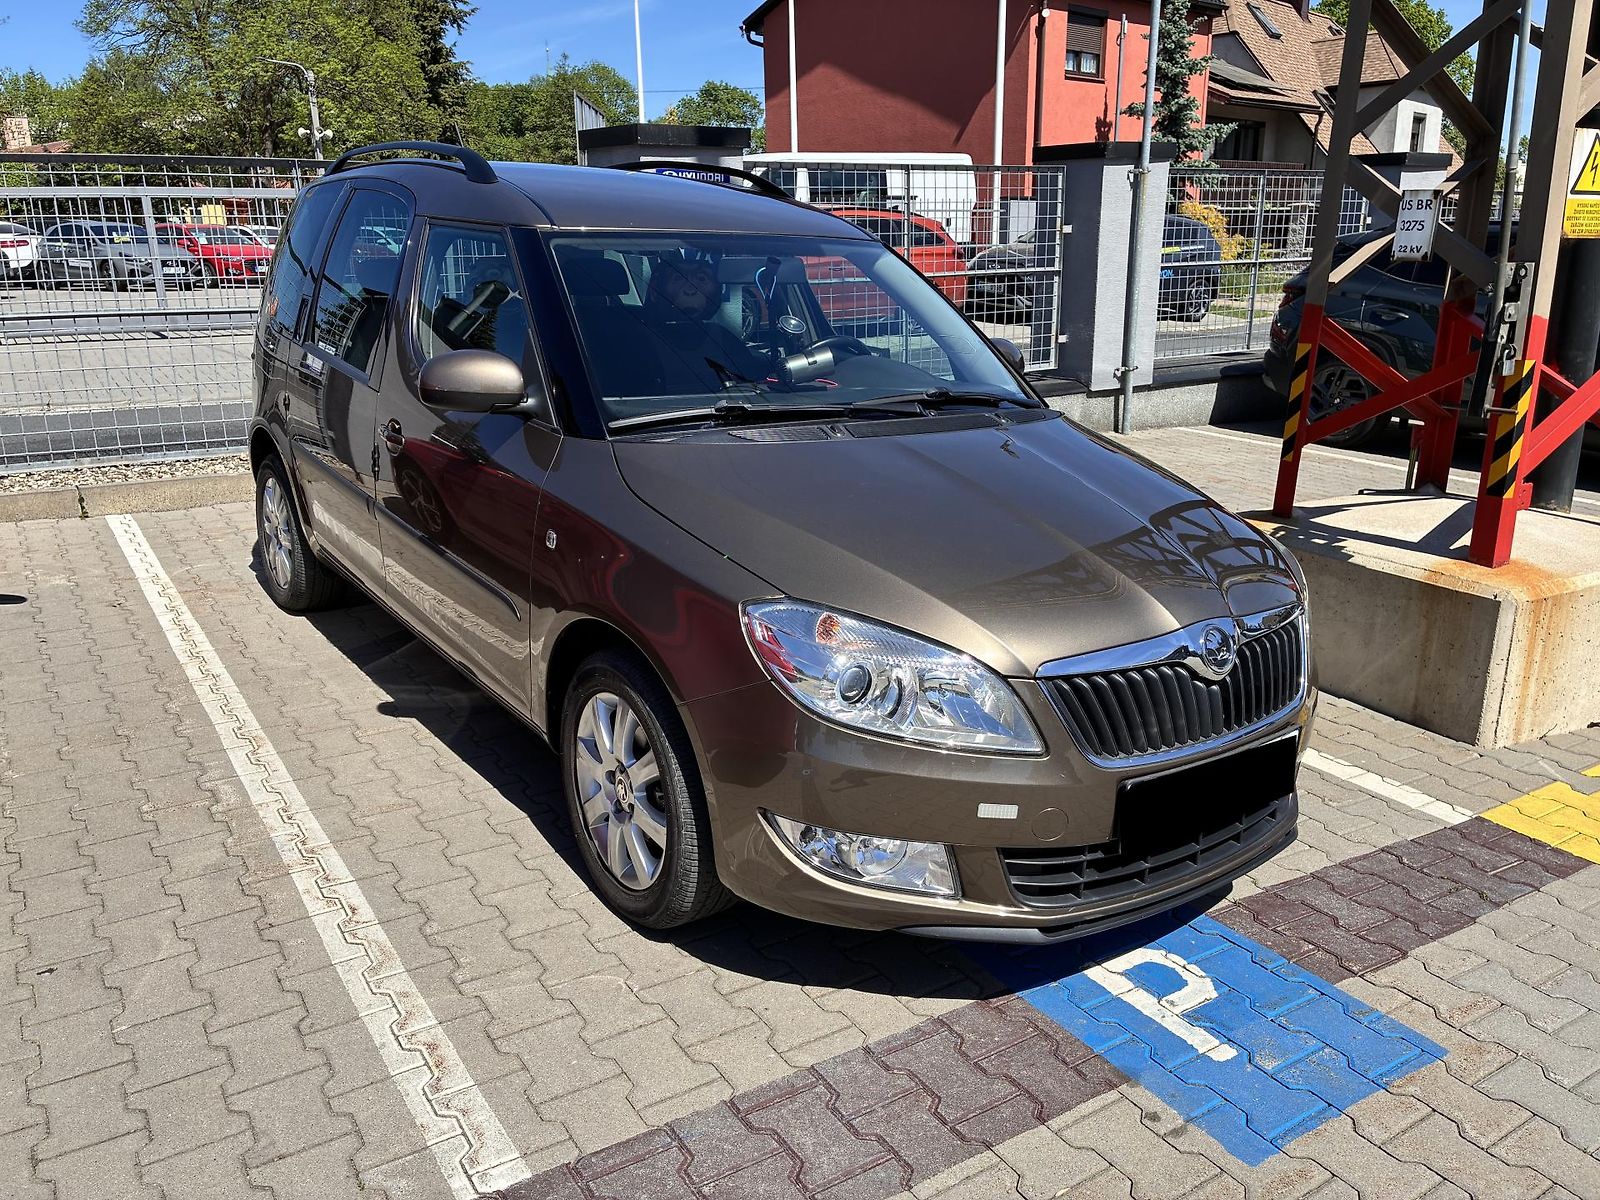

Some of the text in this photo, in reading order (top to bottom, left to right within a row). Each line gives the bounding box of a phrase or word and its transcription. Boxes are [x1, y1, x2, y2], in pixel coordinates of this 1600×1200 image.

[1401, 199, 1433, 211] US BR
[1400, 220, 1425, 231] 3275
[1398, 245, 1423, 254] 22 kV
[1082, 947, 1238, 1062] P
